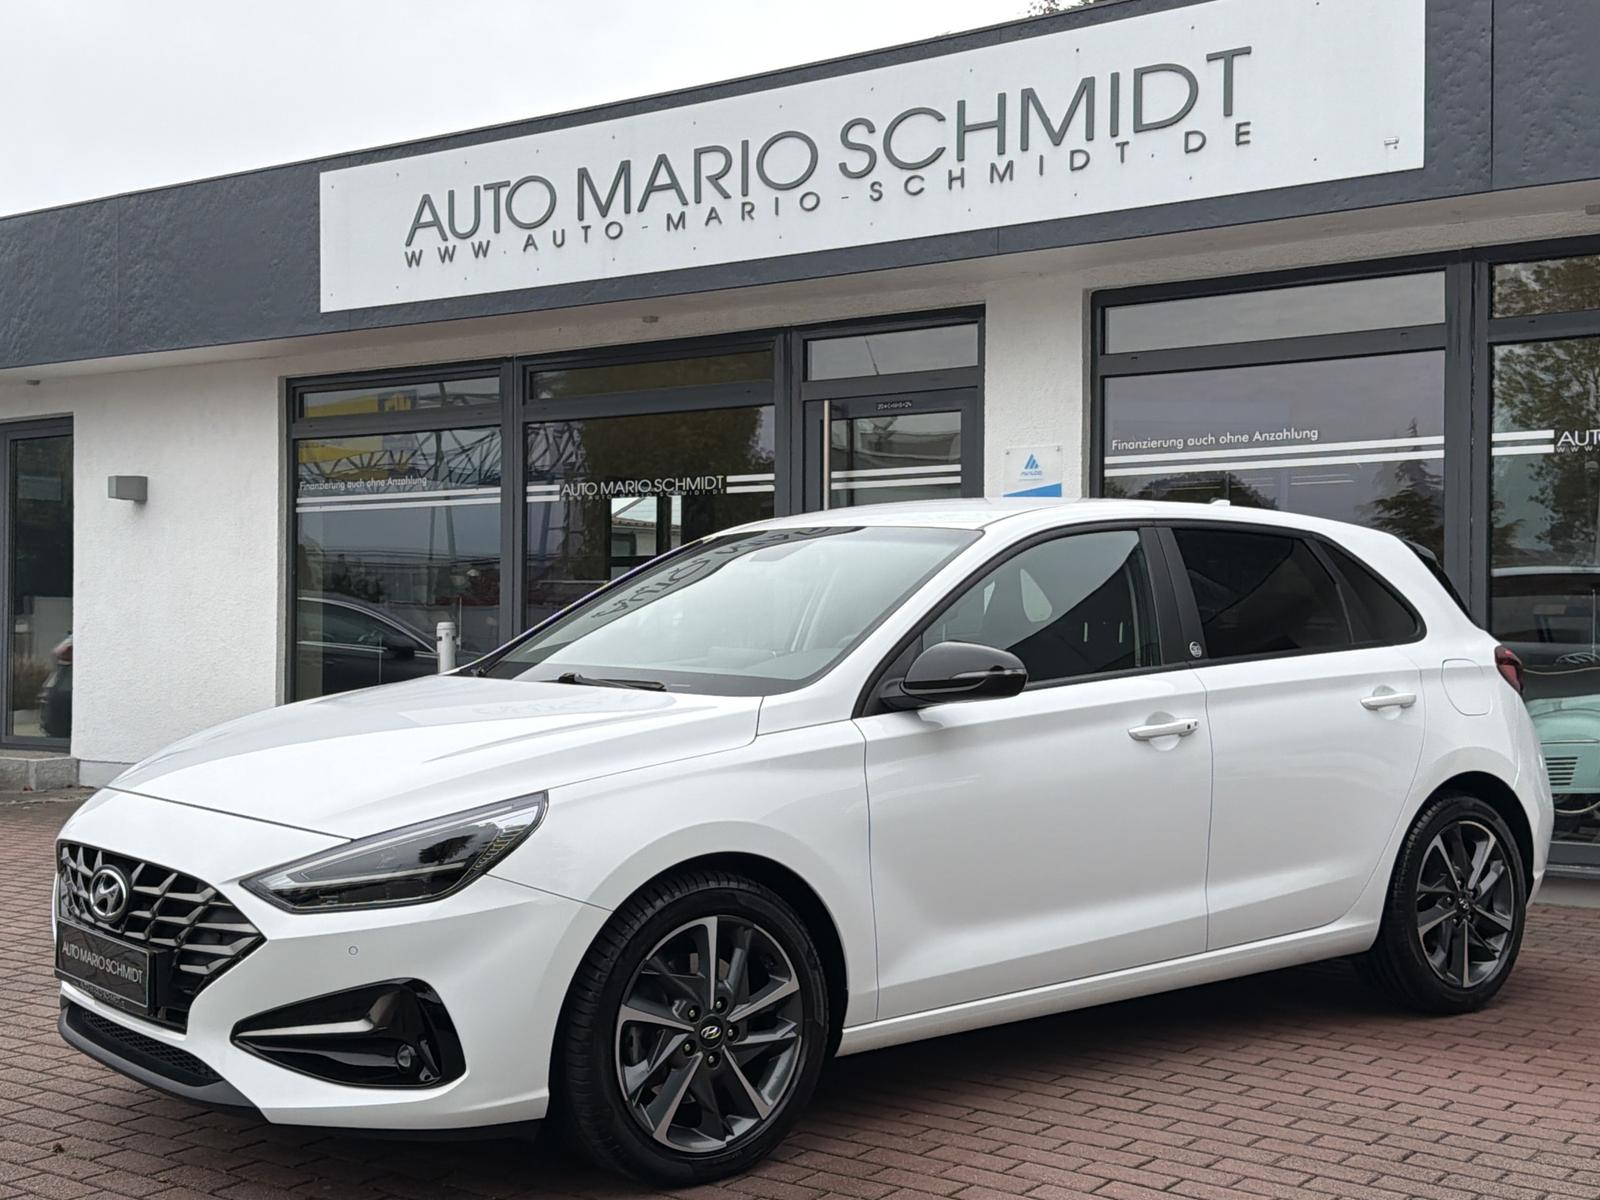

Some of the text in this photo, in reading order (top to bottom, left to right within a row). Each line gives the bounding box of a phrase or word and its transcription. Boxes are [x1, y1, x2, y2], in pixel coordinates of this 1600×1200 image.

[404, 45, 1252, 247] AUTO MARIO SCHMIDT
[1111, 427, 1319, 451] Finanzierung auch ohne Anzahlung
[1556, 429, 1600, 447] AUT
[299, 475, 427, 491] Finanzierung auch ohne Anzahlung
[561, 475, 725, 497] AUTO MARIO SCHMIDT
[62, 941, 144, 984] AUTO MARIO SCHMIDT
